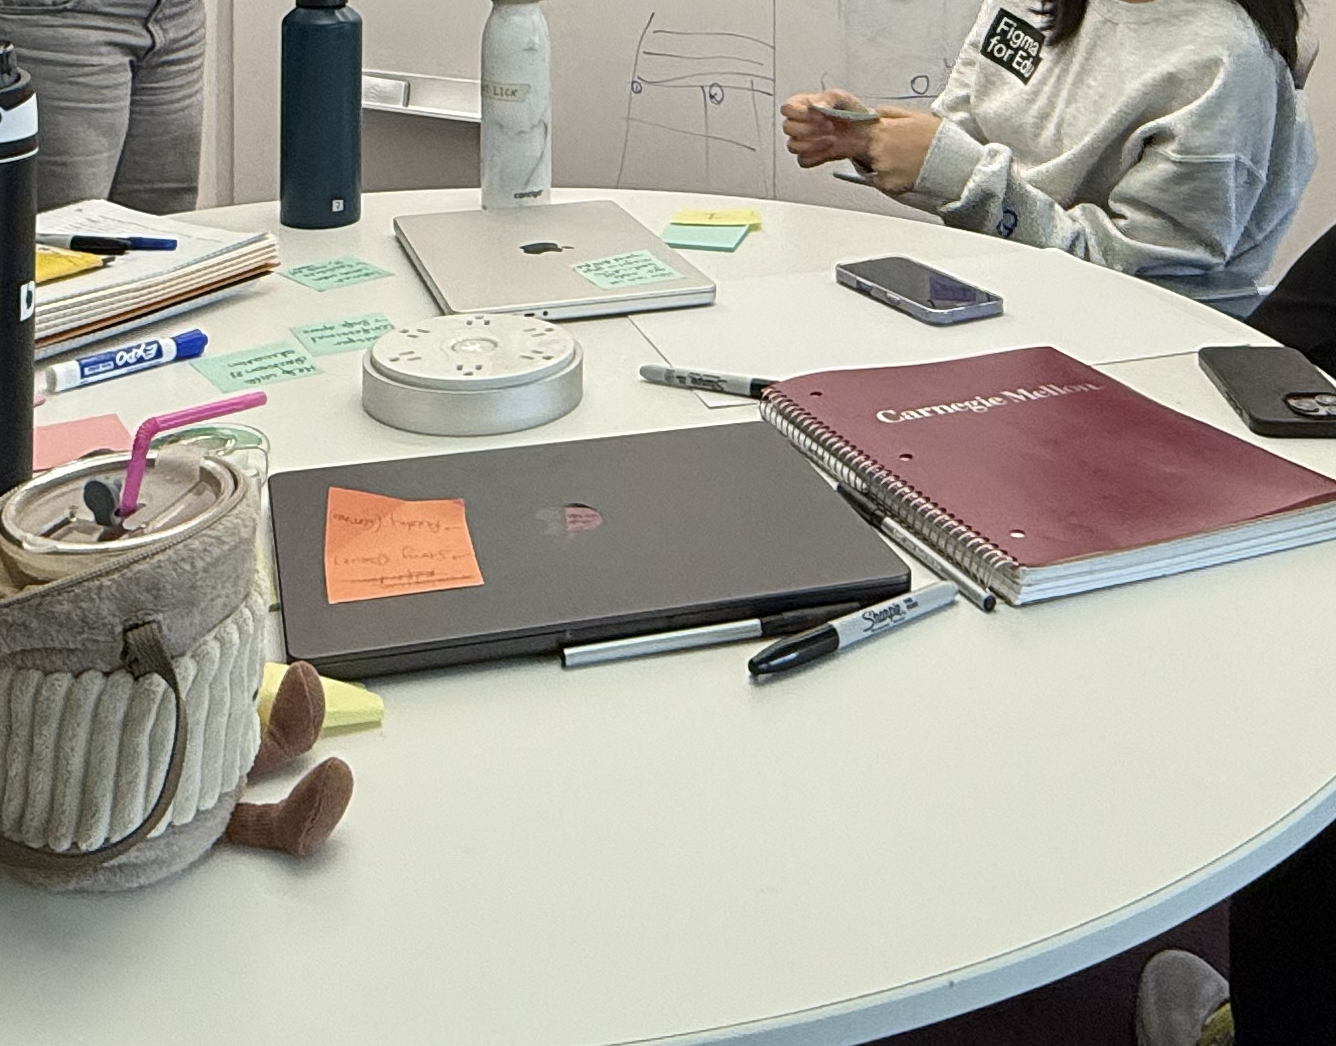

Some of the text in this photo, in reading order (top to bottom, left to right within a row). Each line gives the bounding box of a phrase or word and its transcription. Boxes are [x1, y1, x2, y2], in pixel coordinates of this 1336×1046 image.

[987, 35, 1015, 62] for
[996, 16, 1040, 57] Figma
[115, 343, 158, 366] EXPO
[876, 382, 1101, 424] Carnegie Mellon
[862, 602, 902, 633] Sharpie
